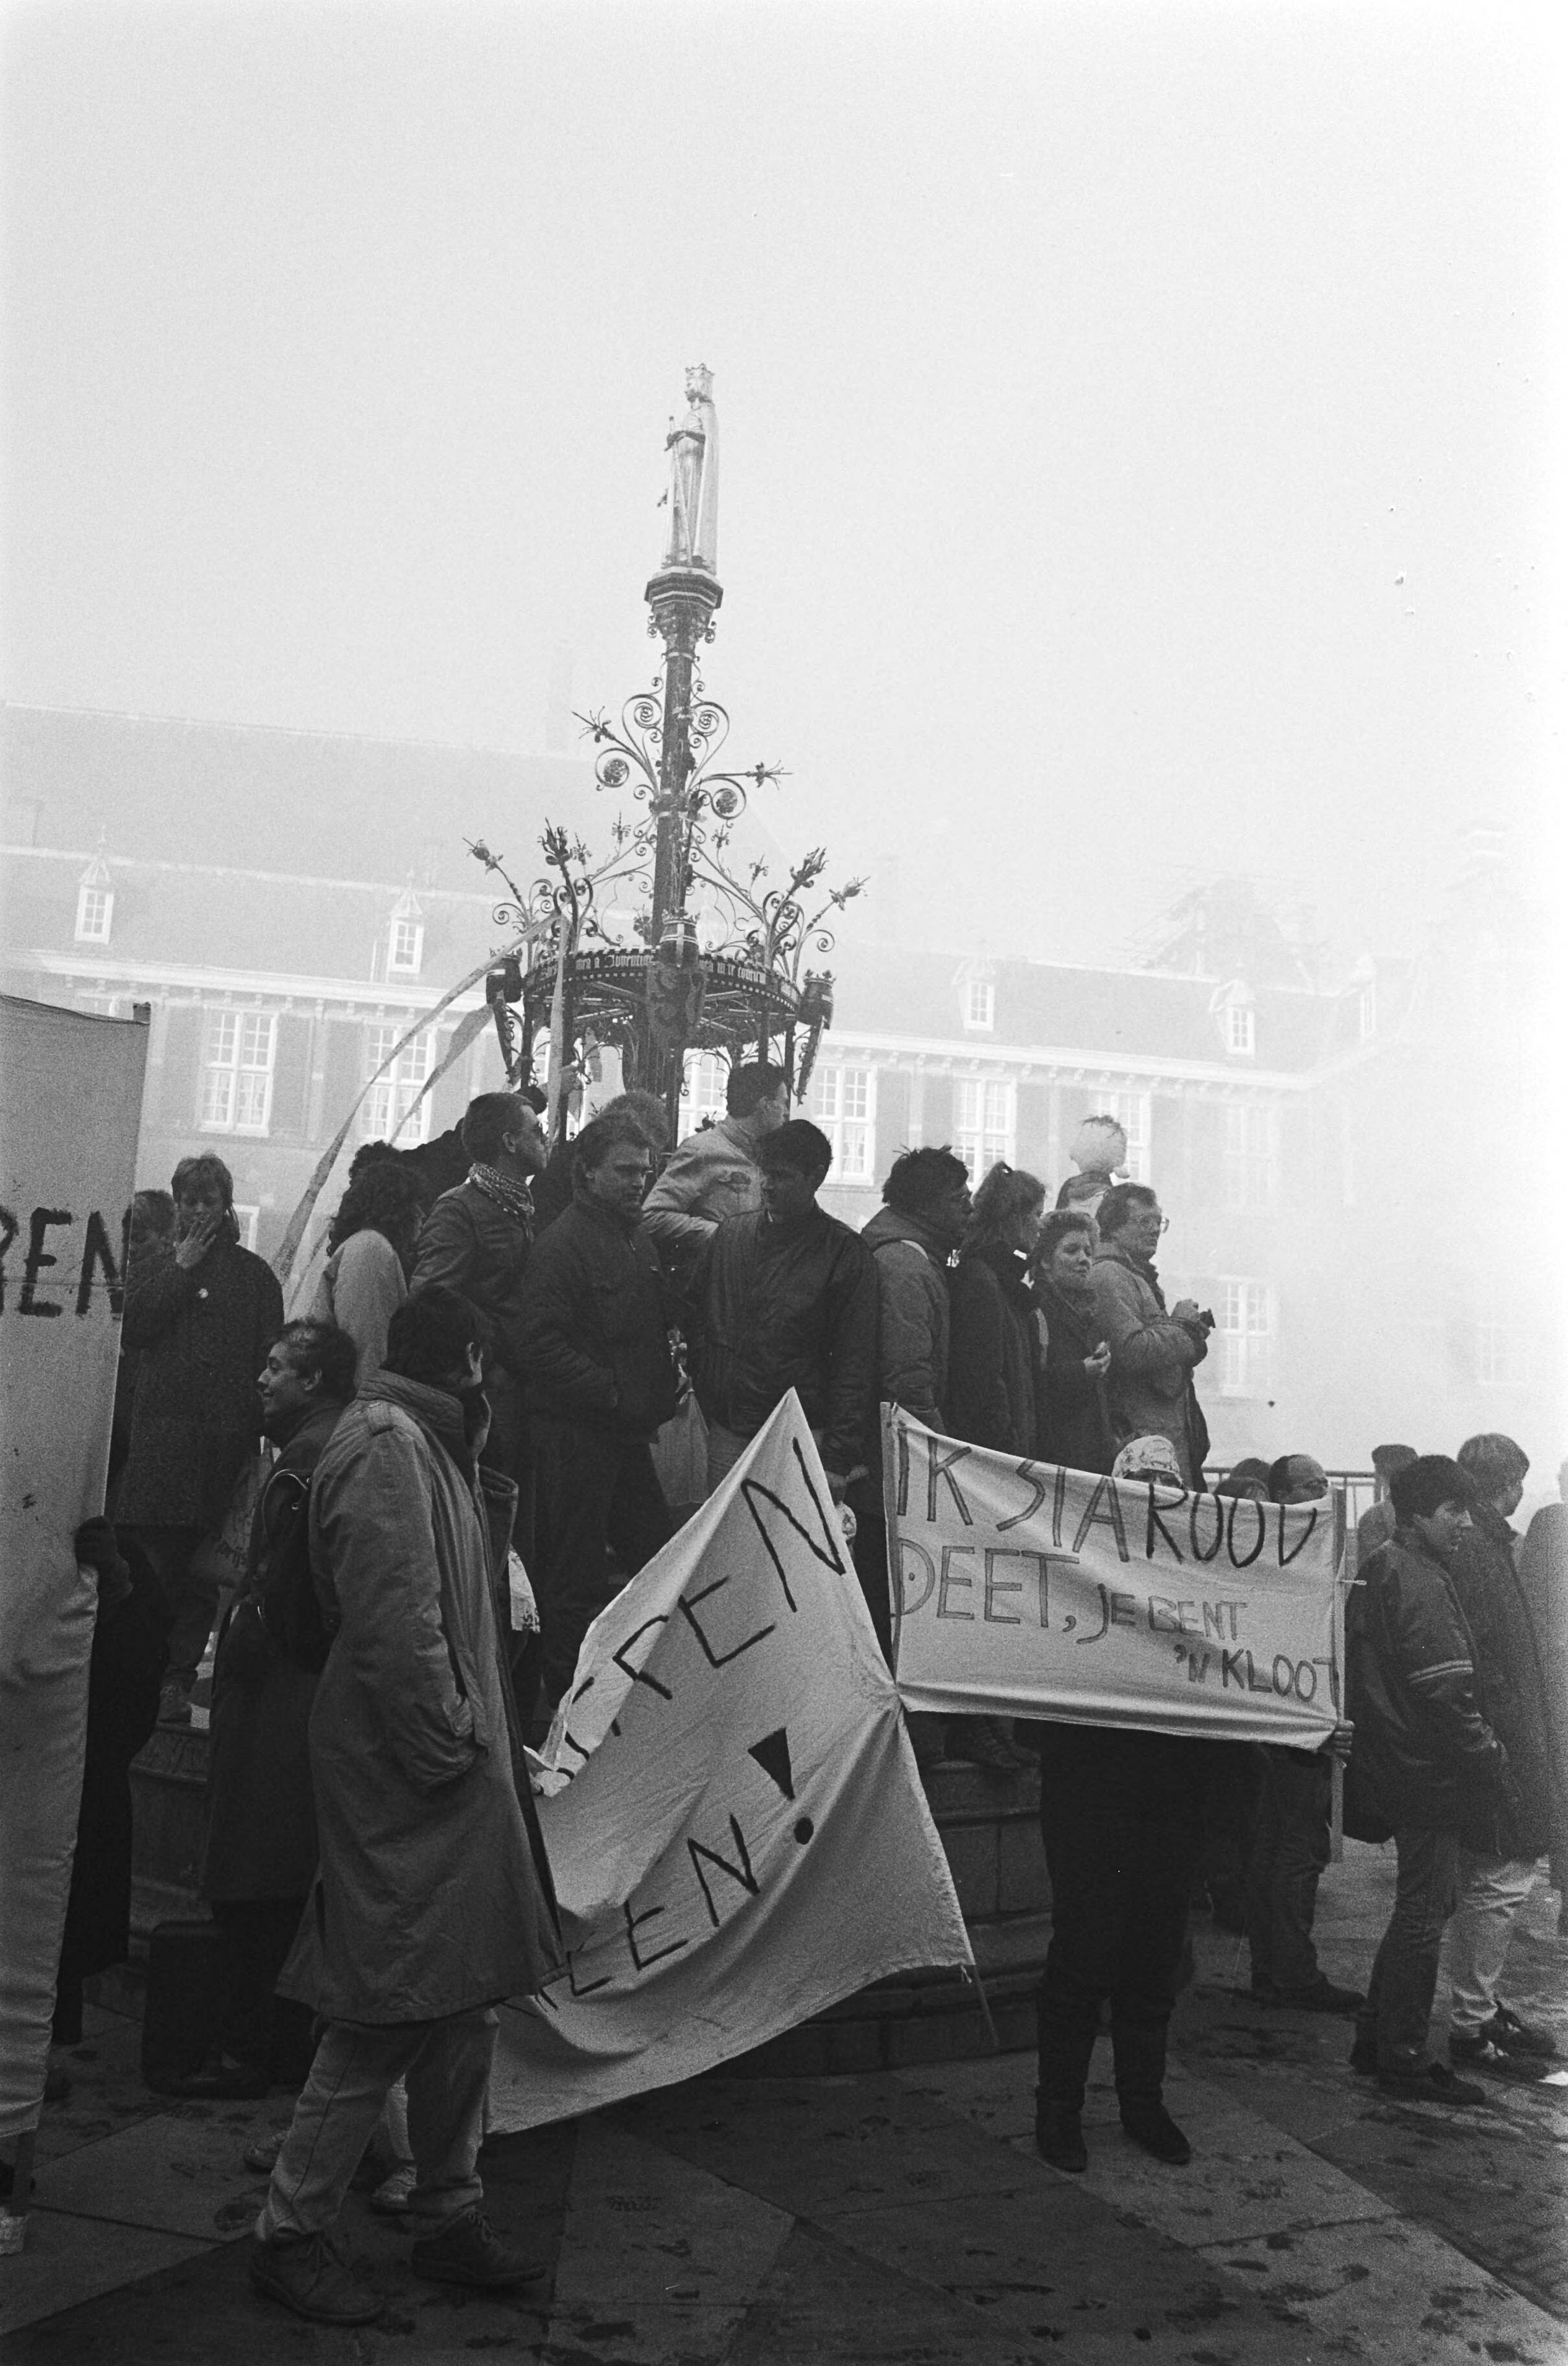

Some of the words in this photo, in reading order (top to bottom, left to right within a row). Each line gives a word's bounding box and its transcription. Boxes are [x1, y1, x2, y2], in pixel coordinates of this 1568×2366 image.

[896, 1428, 973, 1526] IK
[1076, 1583, 1136, 1644] JE
[1148, 1595, 1248, 1640] BENT
